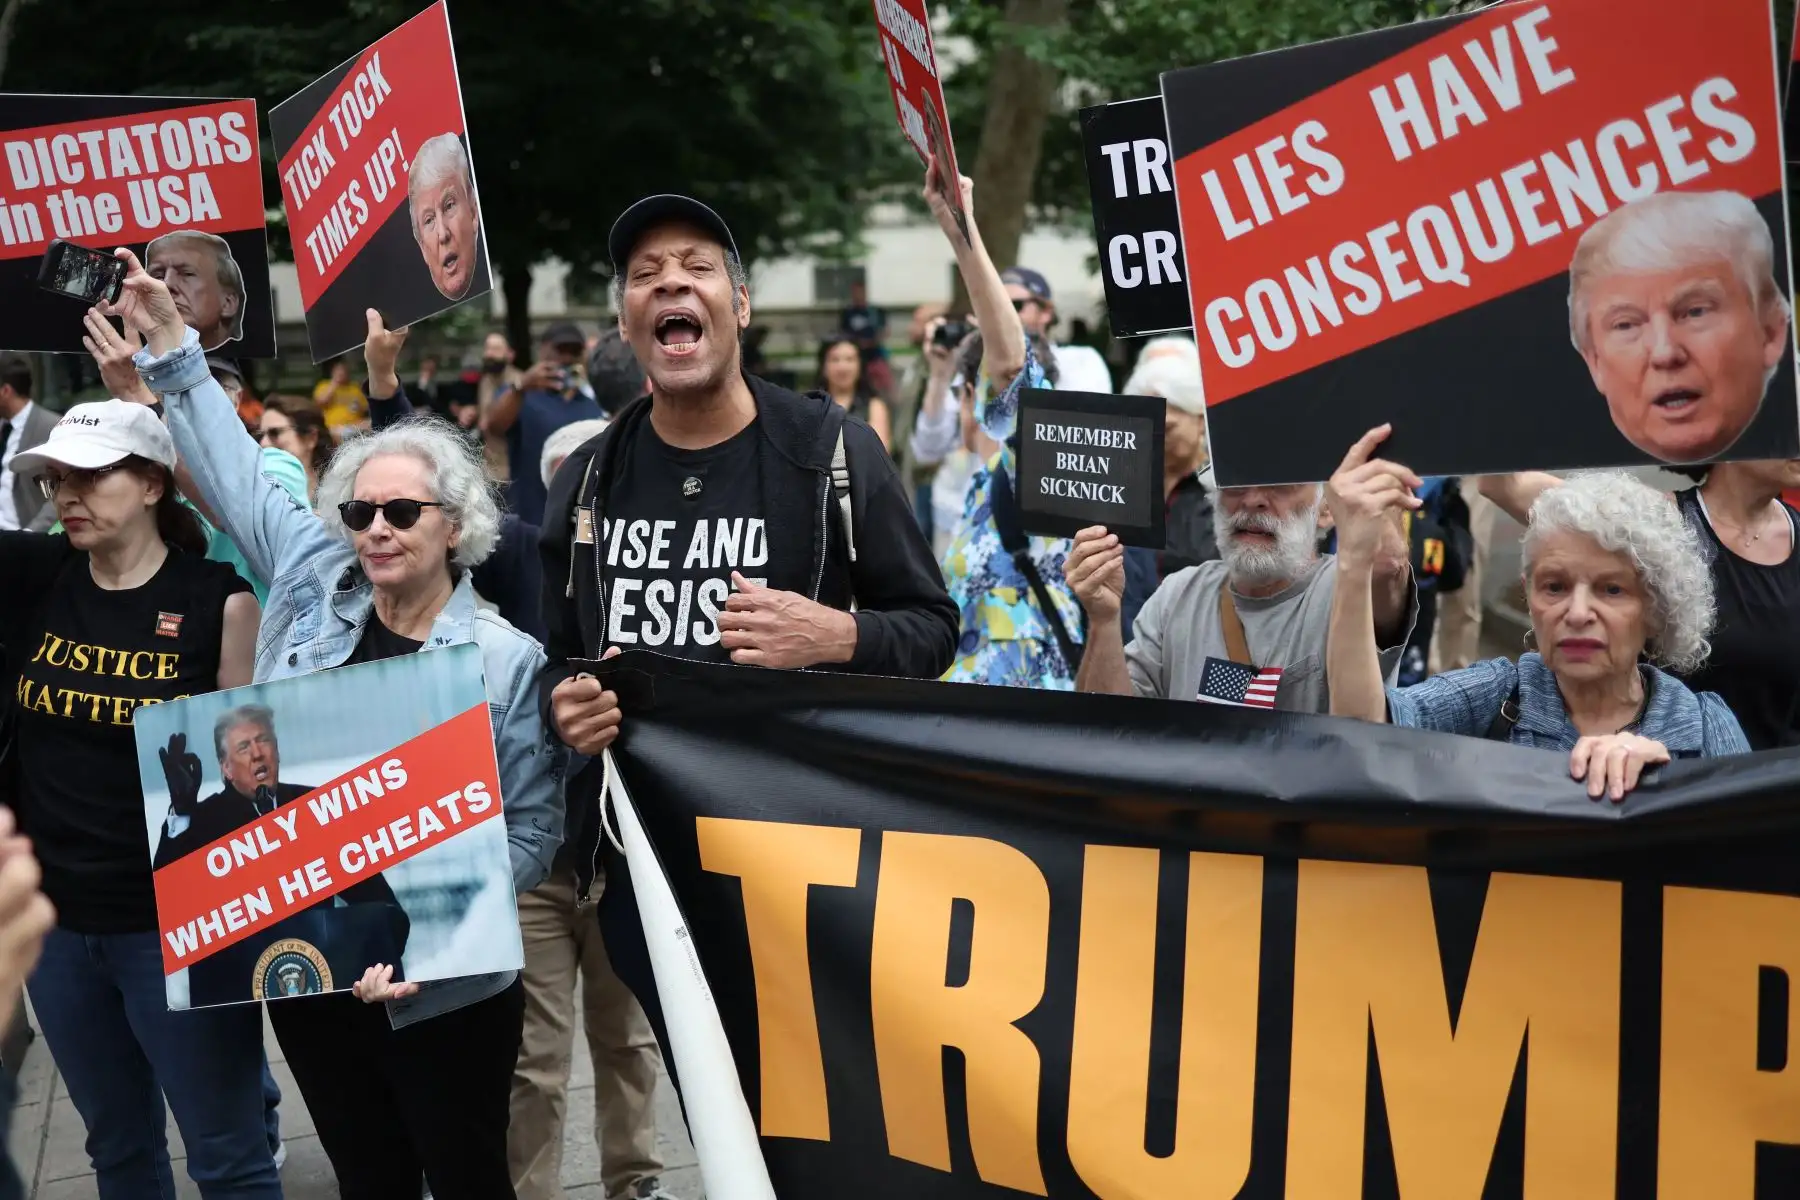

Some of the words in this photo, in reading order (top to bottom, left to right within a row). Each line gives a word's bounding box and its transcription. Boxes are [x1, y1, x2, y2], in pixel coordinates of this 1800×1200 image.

[4, 111, 252, 191] DICTATORS
[284, 125, 336, 211] TICK
[328, 51, 392, 151] TOCK
[1201, 120, 1345, 241] LIES
[1369, 5, 1576, 161] HAVE
[0, 196, 44, 246] in
[46, 188, 123, 238] the
[127, 171, 222, 229] USA
[305, 179, 368, 276] TIMES
[364, 127, 409, 203] UP!
[1204, 77, 1757, 369] CONSEQUENCES
[1034, 423, 1137, 450] REMEMBER
[1056, 452, 1111, 475] BRIAN
[1040, 476, 1126, 504] SICKNICK
[603, 517, 677, 569] ISE
[683, 517, 769, 569] AND
[603, 577, 768, 646] ESIS
[31, 631, 180, 680] JUSTICE
[16, 674, 192, 726] MATTE
[206, 808, 298, 878] ONLY
[306, 758, 408, 827] WINS
[165, 886, 273, 959] WHEN
[278, 857, 333, 905] HE
[339, 780, 492, 874] CHEATS
[309, 950, 331, 989] UNITED
[696, 816, 1800, 1200] TRUMP
